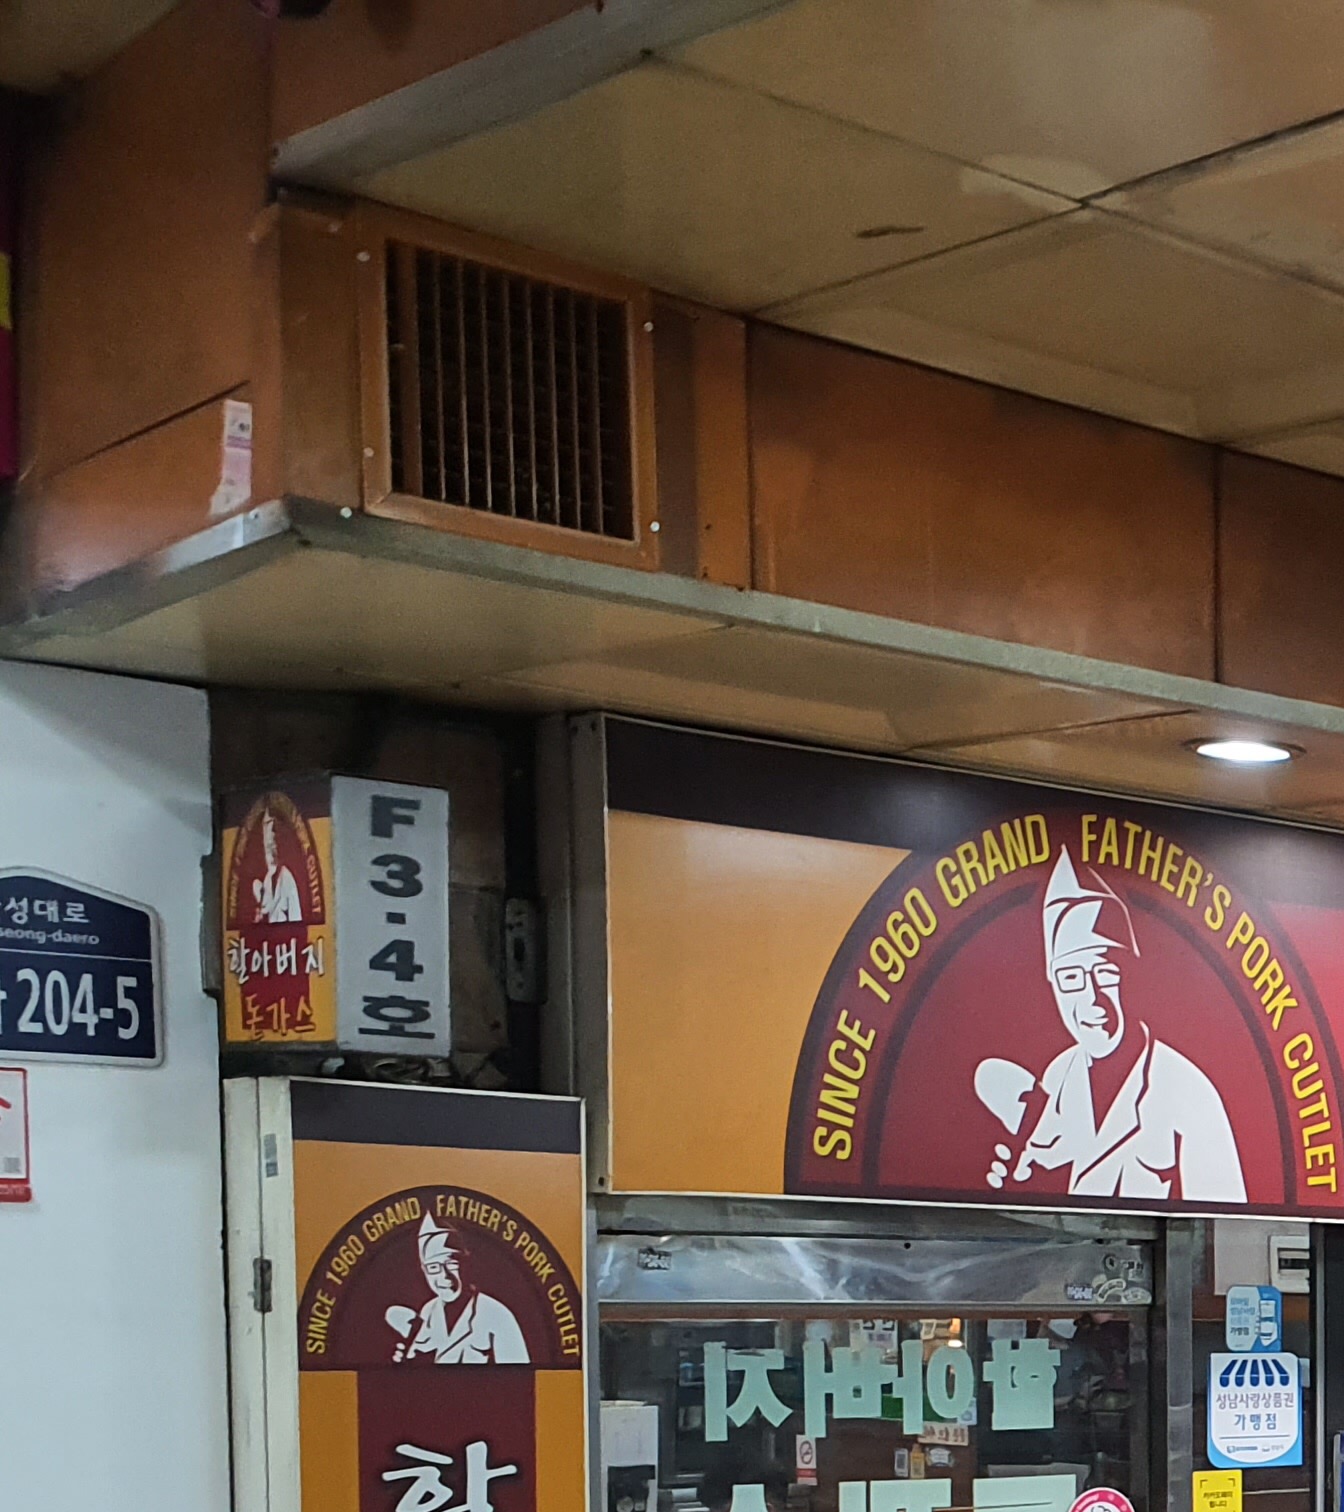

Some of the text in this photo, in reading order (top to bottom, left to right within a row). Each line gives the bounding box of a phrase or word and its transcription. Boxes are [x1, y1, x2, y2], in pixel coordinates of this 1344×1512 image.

[227, 937, 325, 985] 할아버지
[17, 968, 139, 1040] 204-5
[245, 993, 316, 1040] 돈가스
[813, 813, 1339, 1194] SINCE 1960 GRAND FATHER'S PORK CUTLET
[307, 1195, 580, 1357] SINCE 1960 GRAND FATHER'S PORK CUTLET
[1216, 1393, 1294, 1410] 성남사랑상품권
[1234, 1413, 1277, 1431] 가맹점
